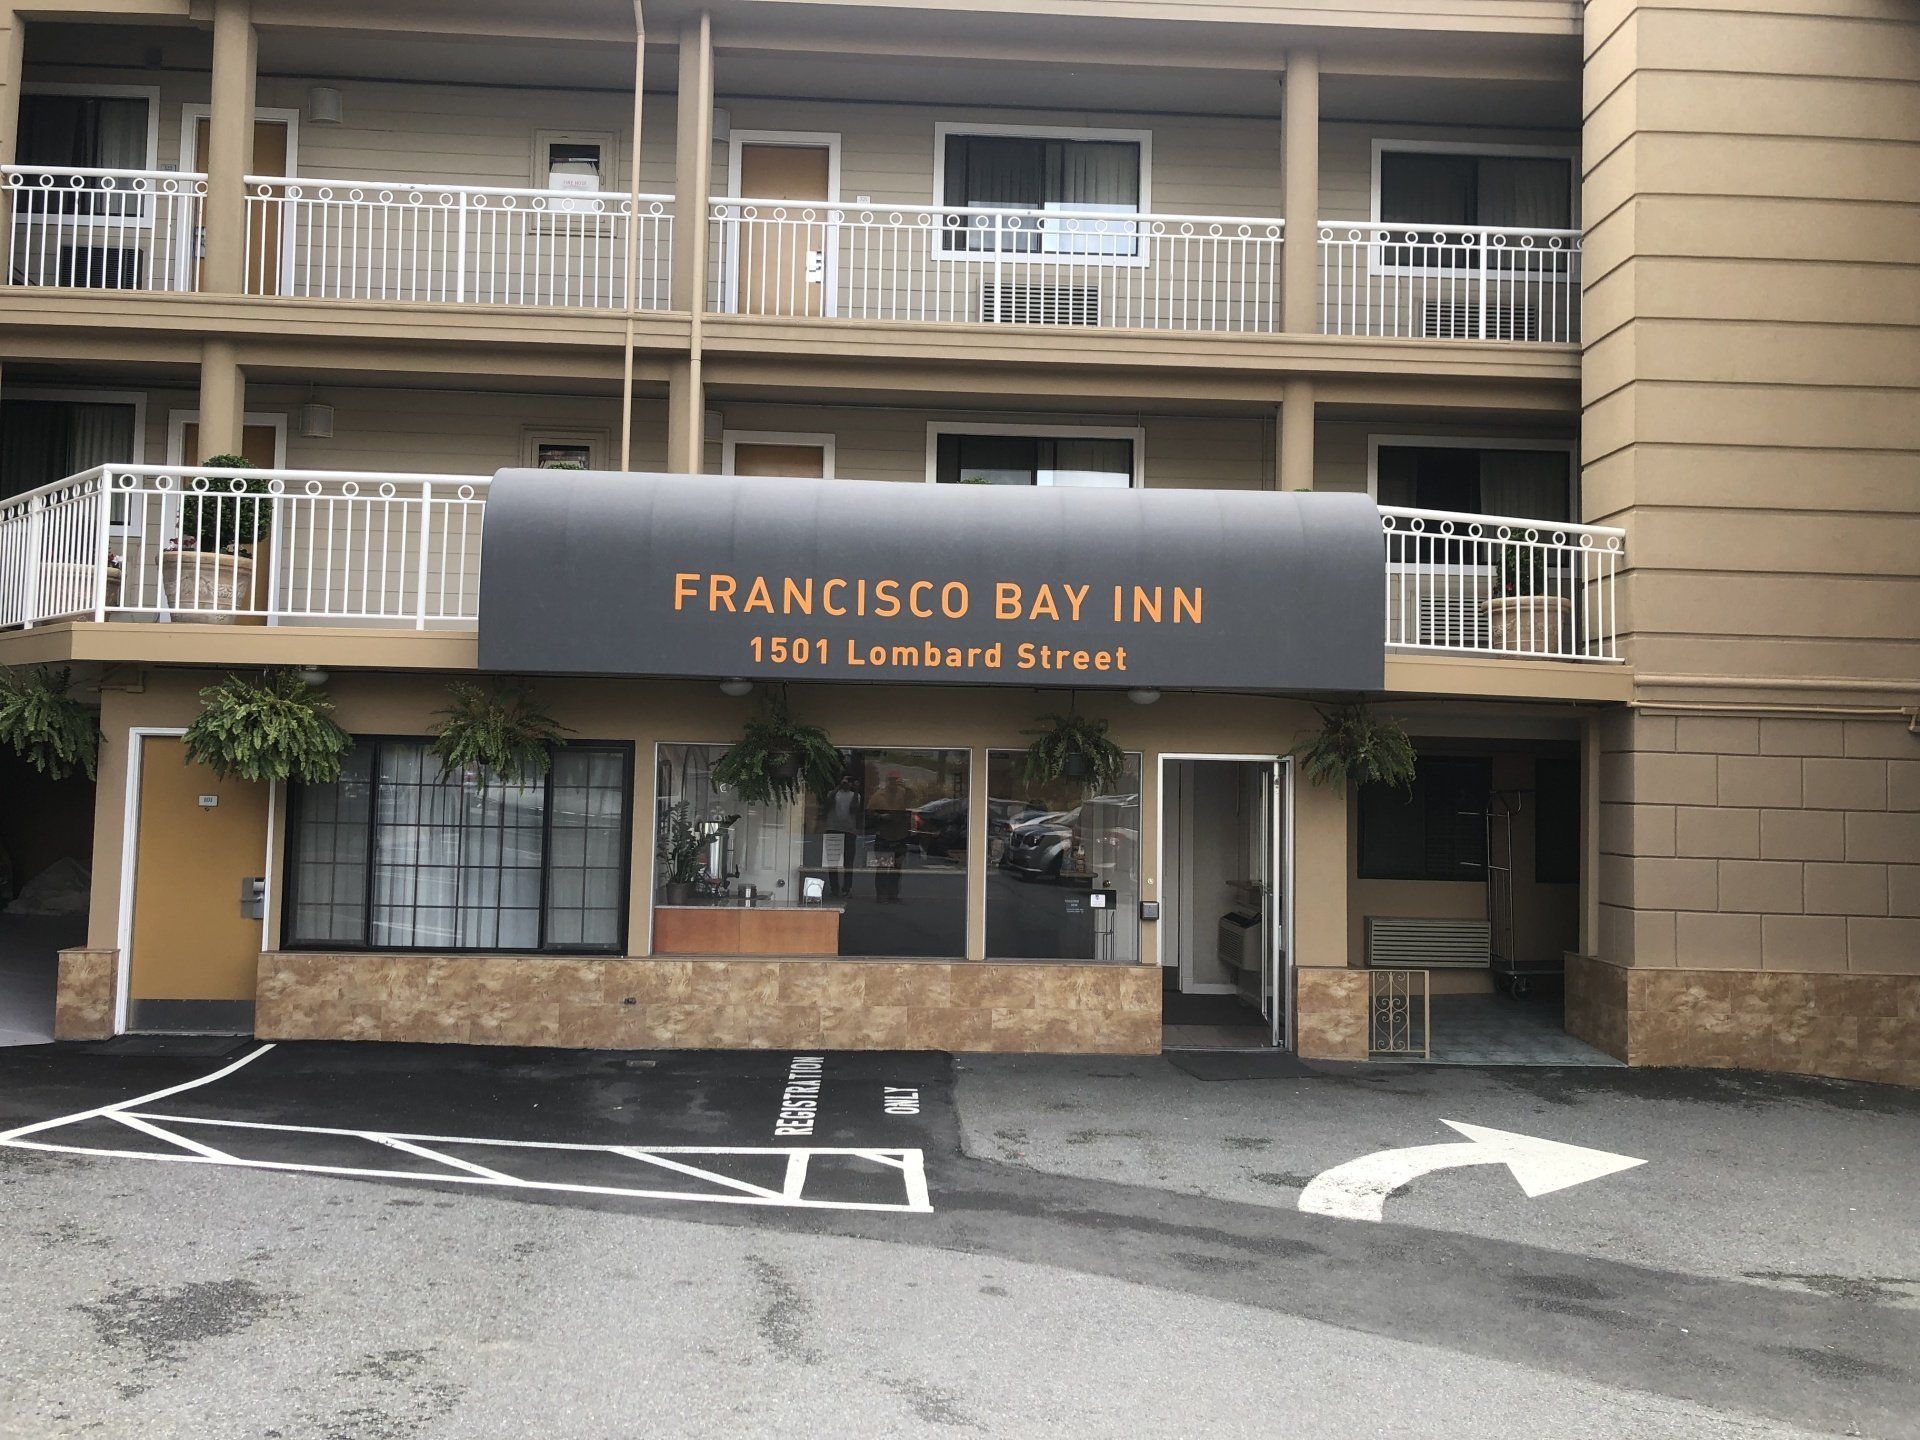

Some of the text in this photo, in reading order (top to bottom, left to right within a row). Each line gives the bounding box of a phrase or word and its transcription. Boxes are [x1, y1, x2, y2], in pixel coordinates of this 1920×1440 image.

[674, 573, 1204, 625] FRANCISCO BAY INN
[751, 636, 1128, 671] 1501 Lombard Street
[774, 1056, 825, 1136] REGISTRATION
[884, 1086, 920, 1115] ONLY
